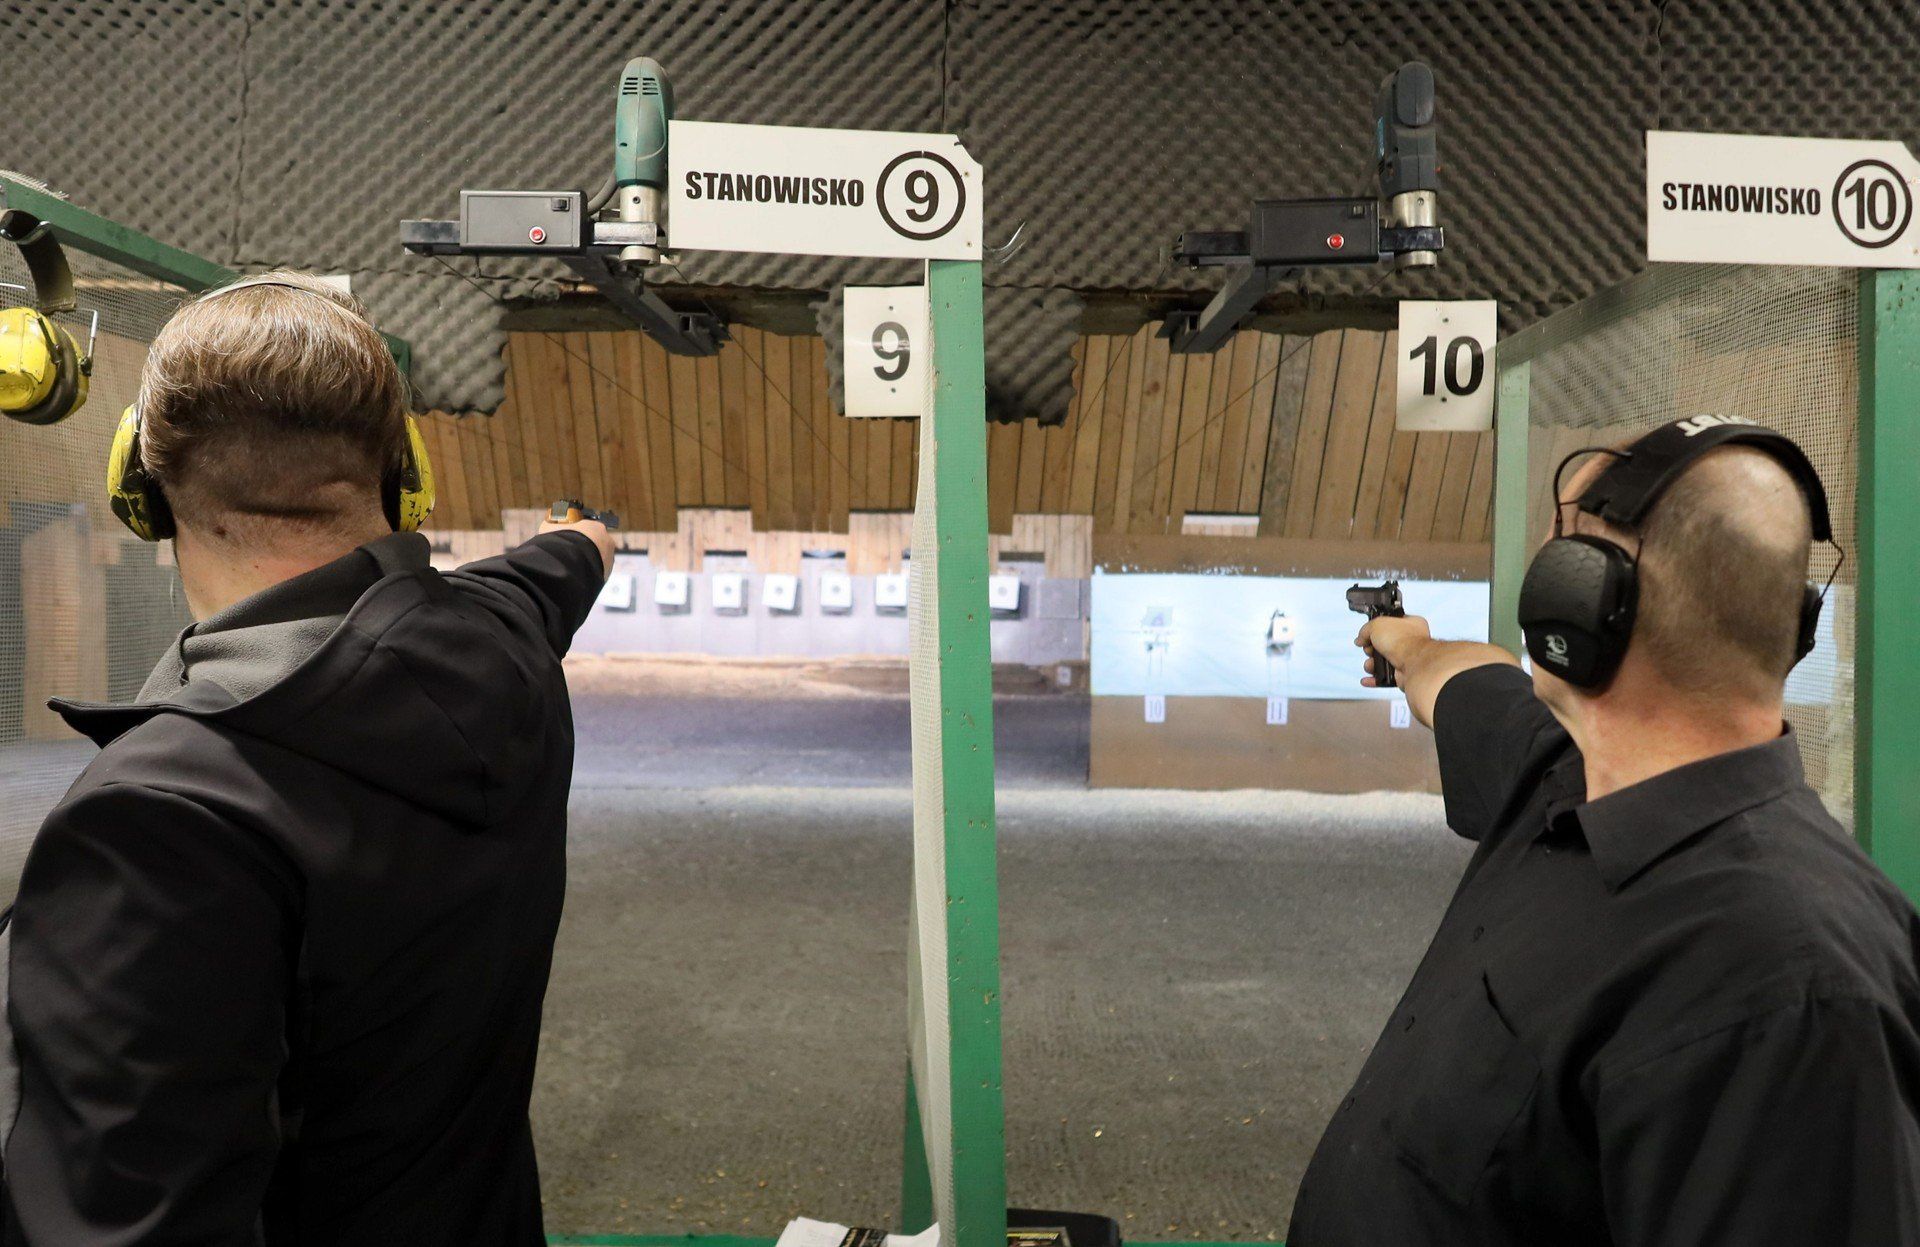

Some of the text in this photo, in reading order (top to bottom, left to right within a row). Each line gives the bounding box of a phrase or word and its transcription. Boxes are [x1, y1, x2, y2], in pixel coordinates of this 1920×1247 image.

[686, 169, 940, 223] STANOWISKO 9
[1662, 178, 1898, 232] STANOWISKO 10
[871, 321, 911, 381] 9
[1409, 336, 1485, 397] 10
[1148, 700, 1163, 719] 10
[1269, 701, 1283, 720] 11
[1393, 703, 1406, 724] 12
